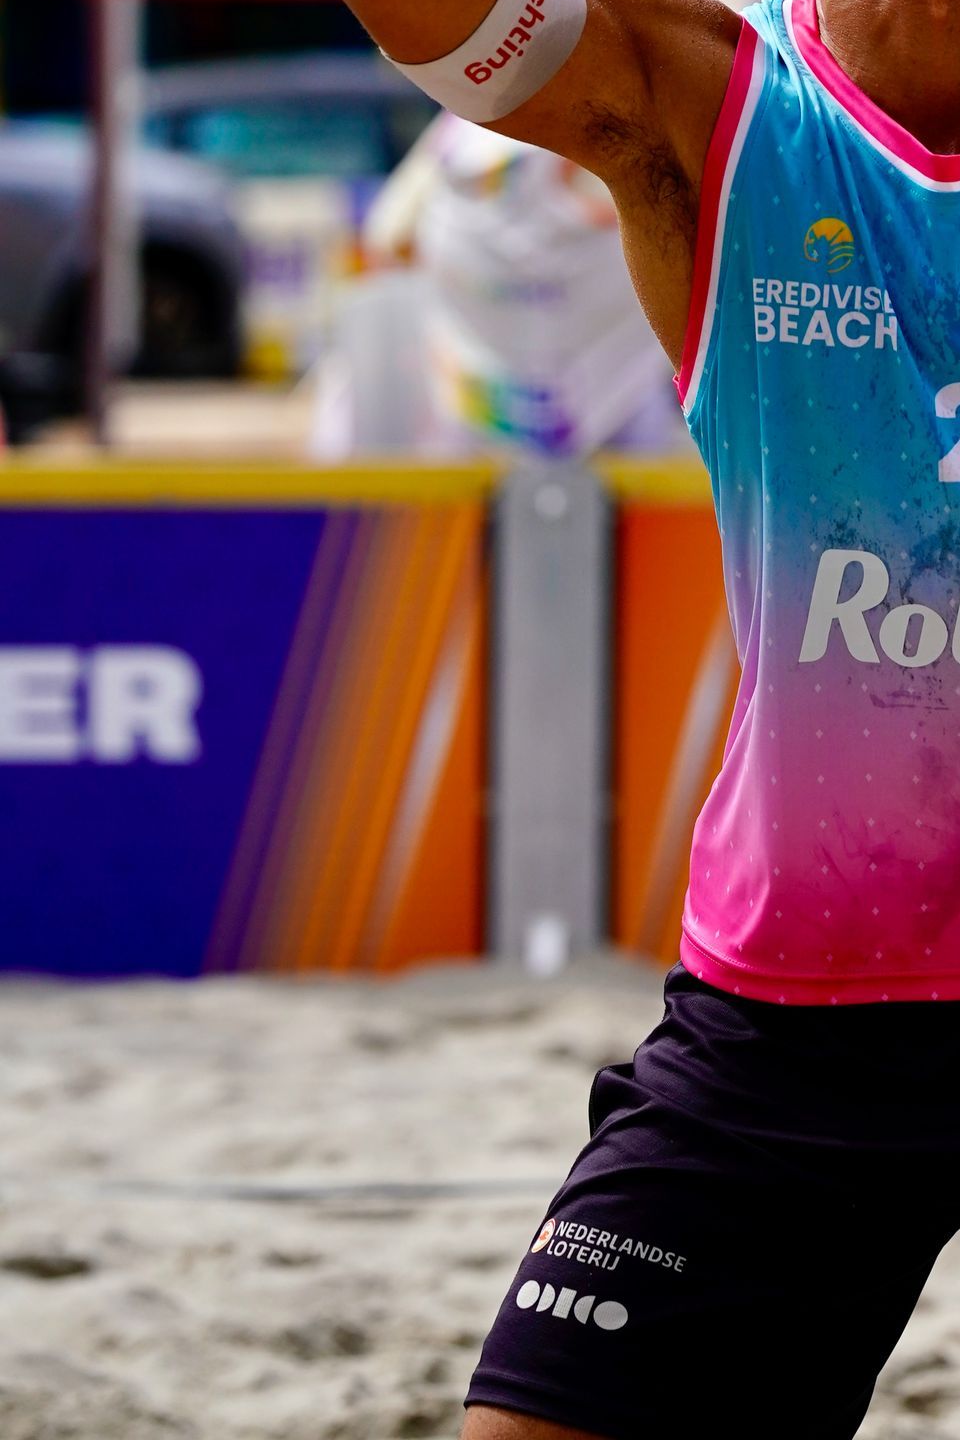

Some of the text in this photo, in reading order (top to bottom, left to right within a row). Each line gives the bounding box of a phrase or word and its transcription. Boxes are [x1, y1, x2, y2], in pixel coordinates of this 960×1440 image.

[752, 278, 896, 314] EREDIVIS
[754, 304, 898, 352] BEACH
[0, 643, 203, 763] ER
[547, 1239, 620, 1271] LOTERIJ
[555, 1220, 687, 1273] NEDERLANDSE
